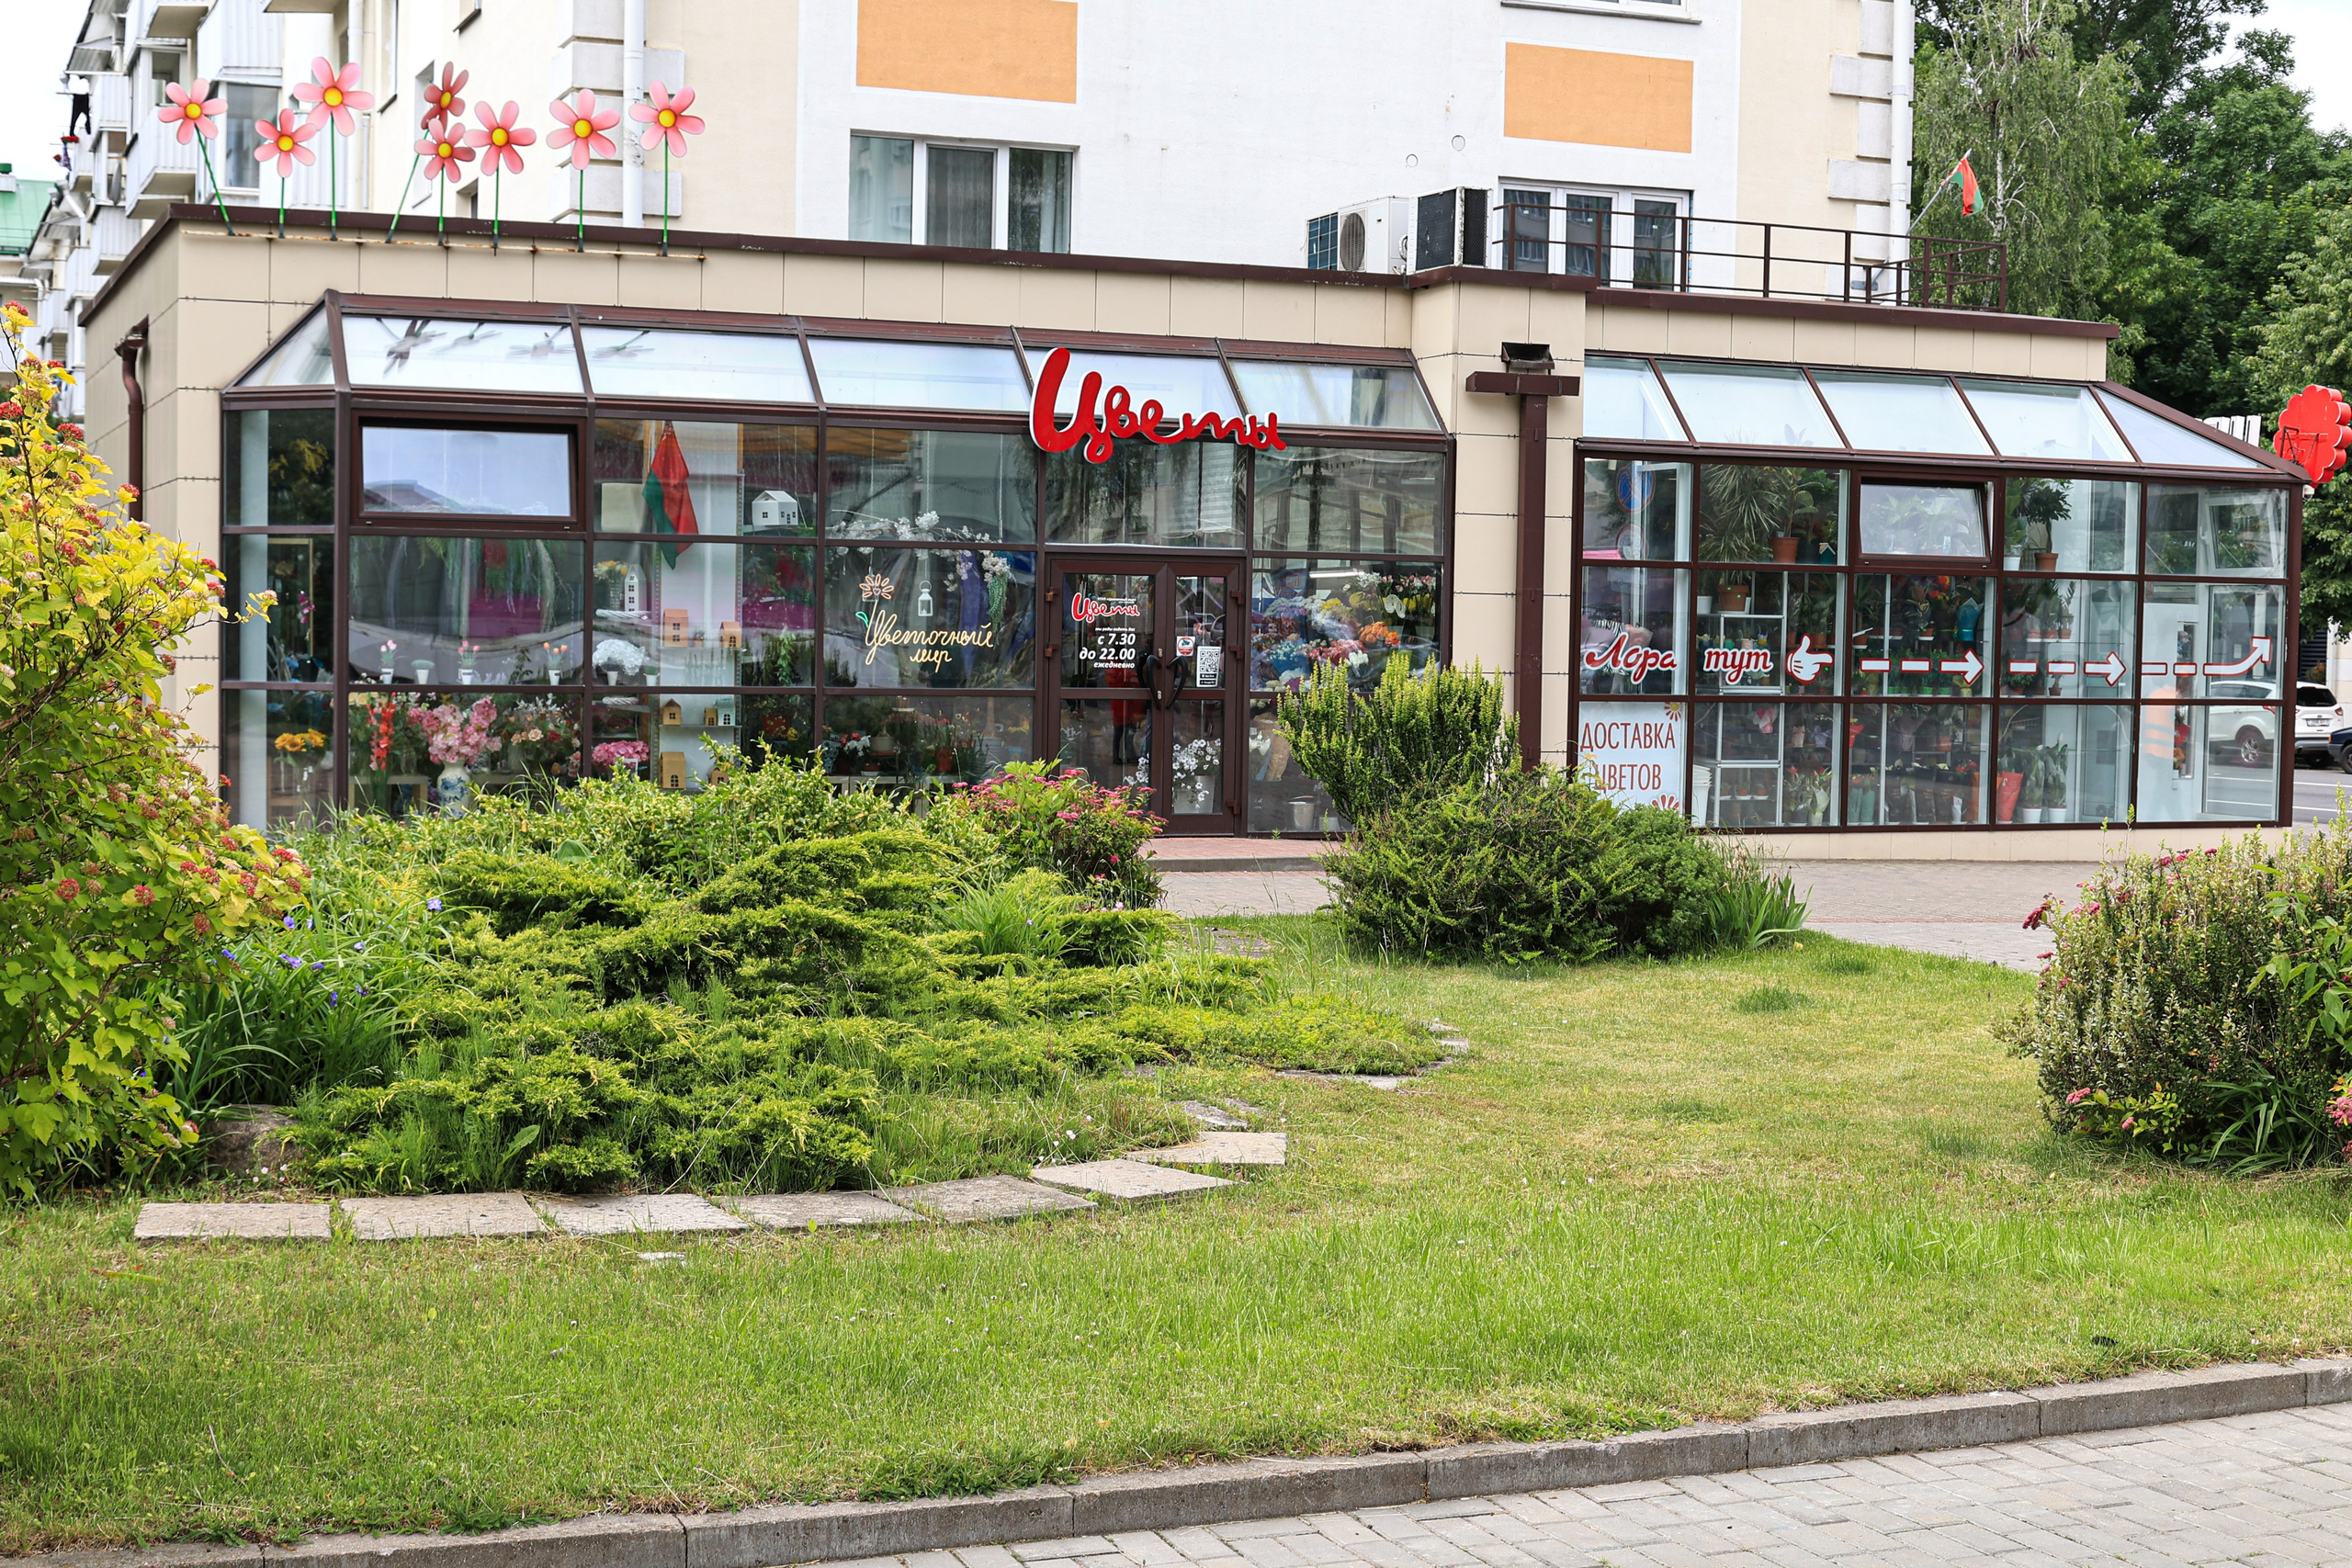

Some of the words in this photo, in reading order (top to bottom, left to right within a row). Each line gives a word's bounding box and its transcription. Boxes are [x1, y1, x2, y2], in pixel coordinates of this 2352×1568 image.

[1029, 347, 1286, 464] Цветы
[1071, 592, 1140, 623] Цветы
[865, 604, 993, 665] Цветочный
[1097, 636, 1105, 645] с
[1108, 633, 1136, 645] 7.30
[910, 648, 952, 673] мир
[1079, 647, 1096, 660] до
[1099, 648, 1136, 660] 22.00
[1093, 660, 1136, 669] ежедневно
[1584, 632, 1679, 684] Лора
[1703, 648, 1773, 684] тут
[1580, 722, 1676, 752] ДОСТАВКА
